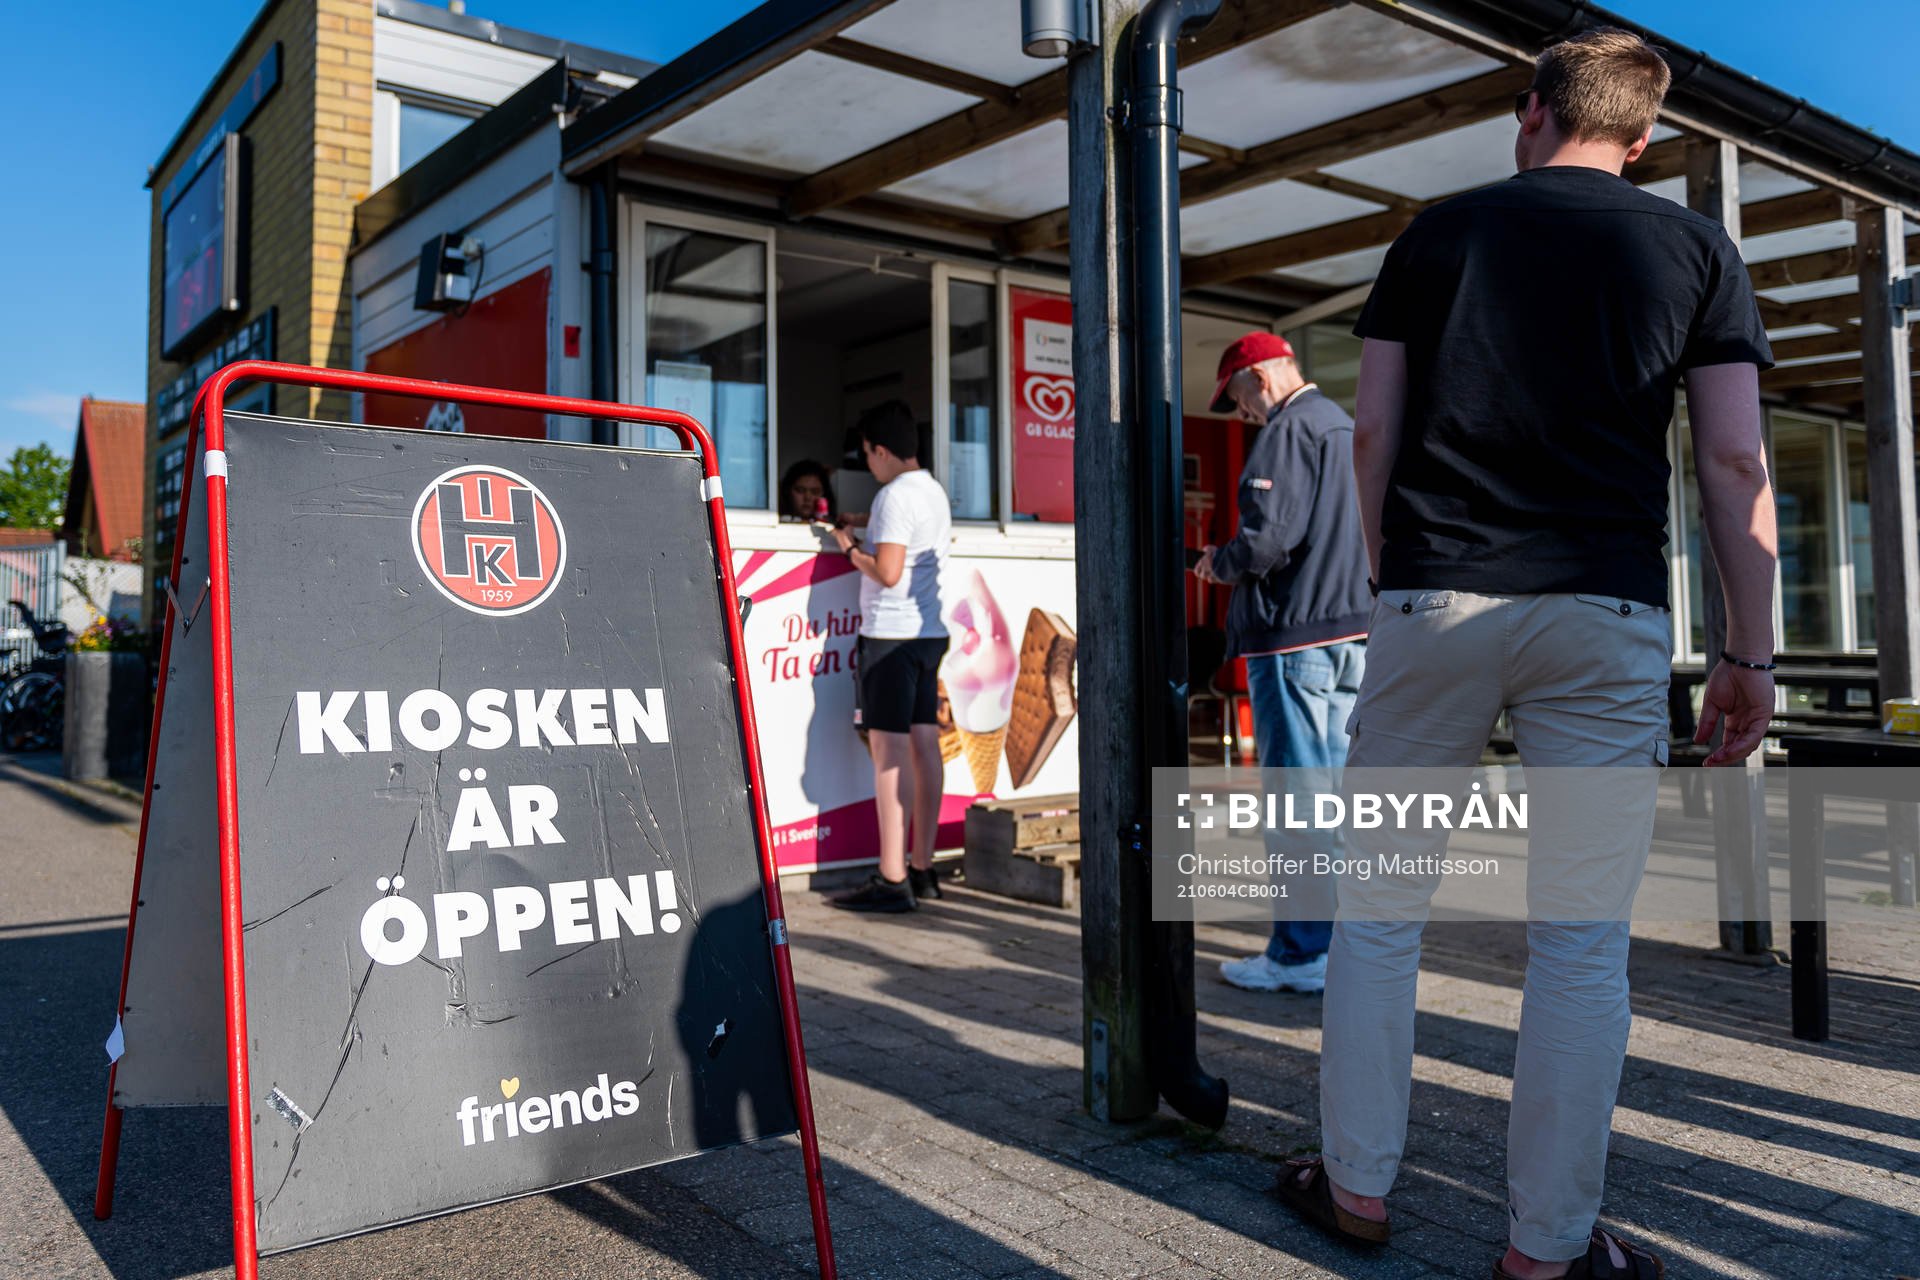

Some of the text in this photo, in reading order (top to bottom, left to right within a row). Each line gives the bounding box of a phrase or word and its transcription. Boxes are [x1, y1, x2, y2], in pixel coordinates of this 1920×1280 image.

[481, 589, 513, 603] 1959
[783, 613, 819, 642] Du
[763, 646, 800, 682] Ta
[809, 649, 841, 677] en
[296, 688, 670, 754] KIOSKEN
[446, 767, 566, 852] ÄR
[360, 869, 682, 966] ÖPPEN!
[456, 1073, 640, 1147] friends
